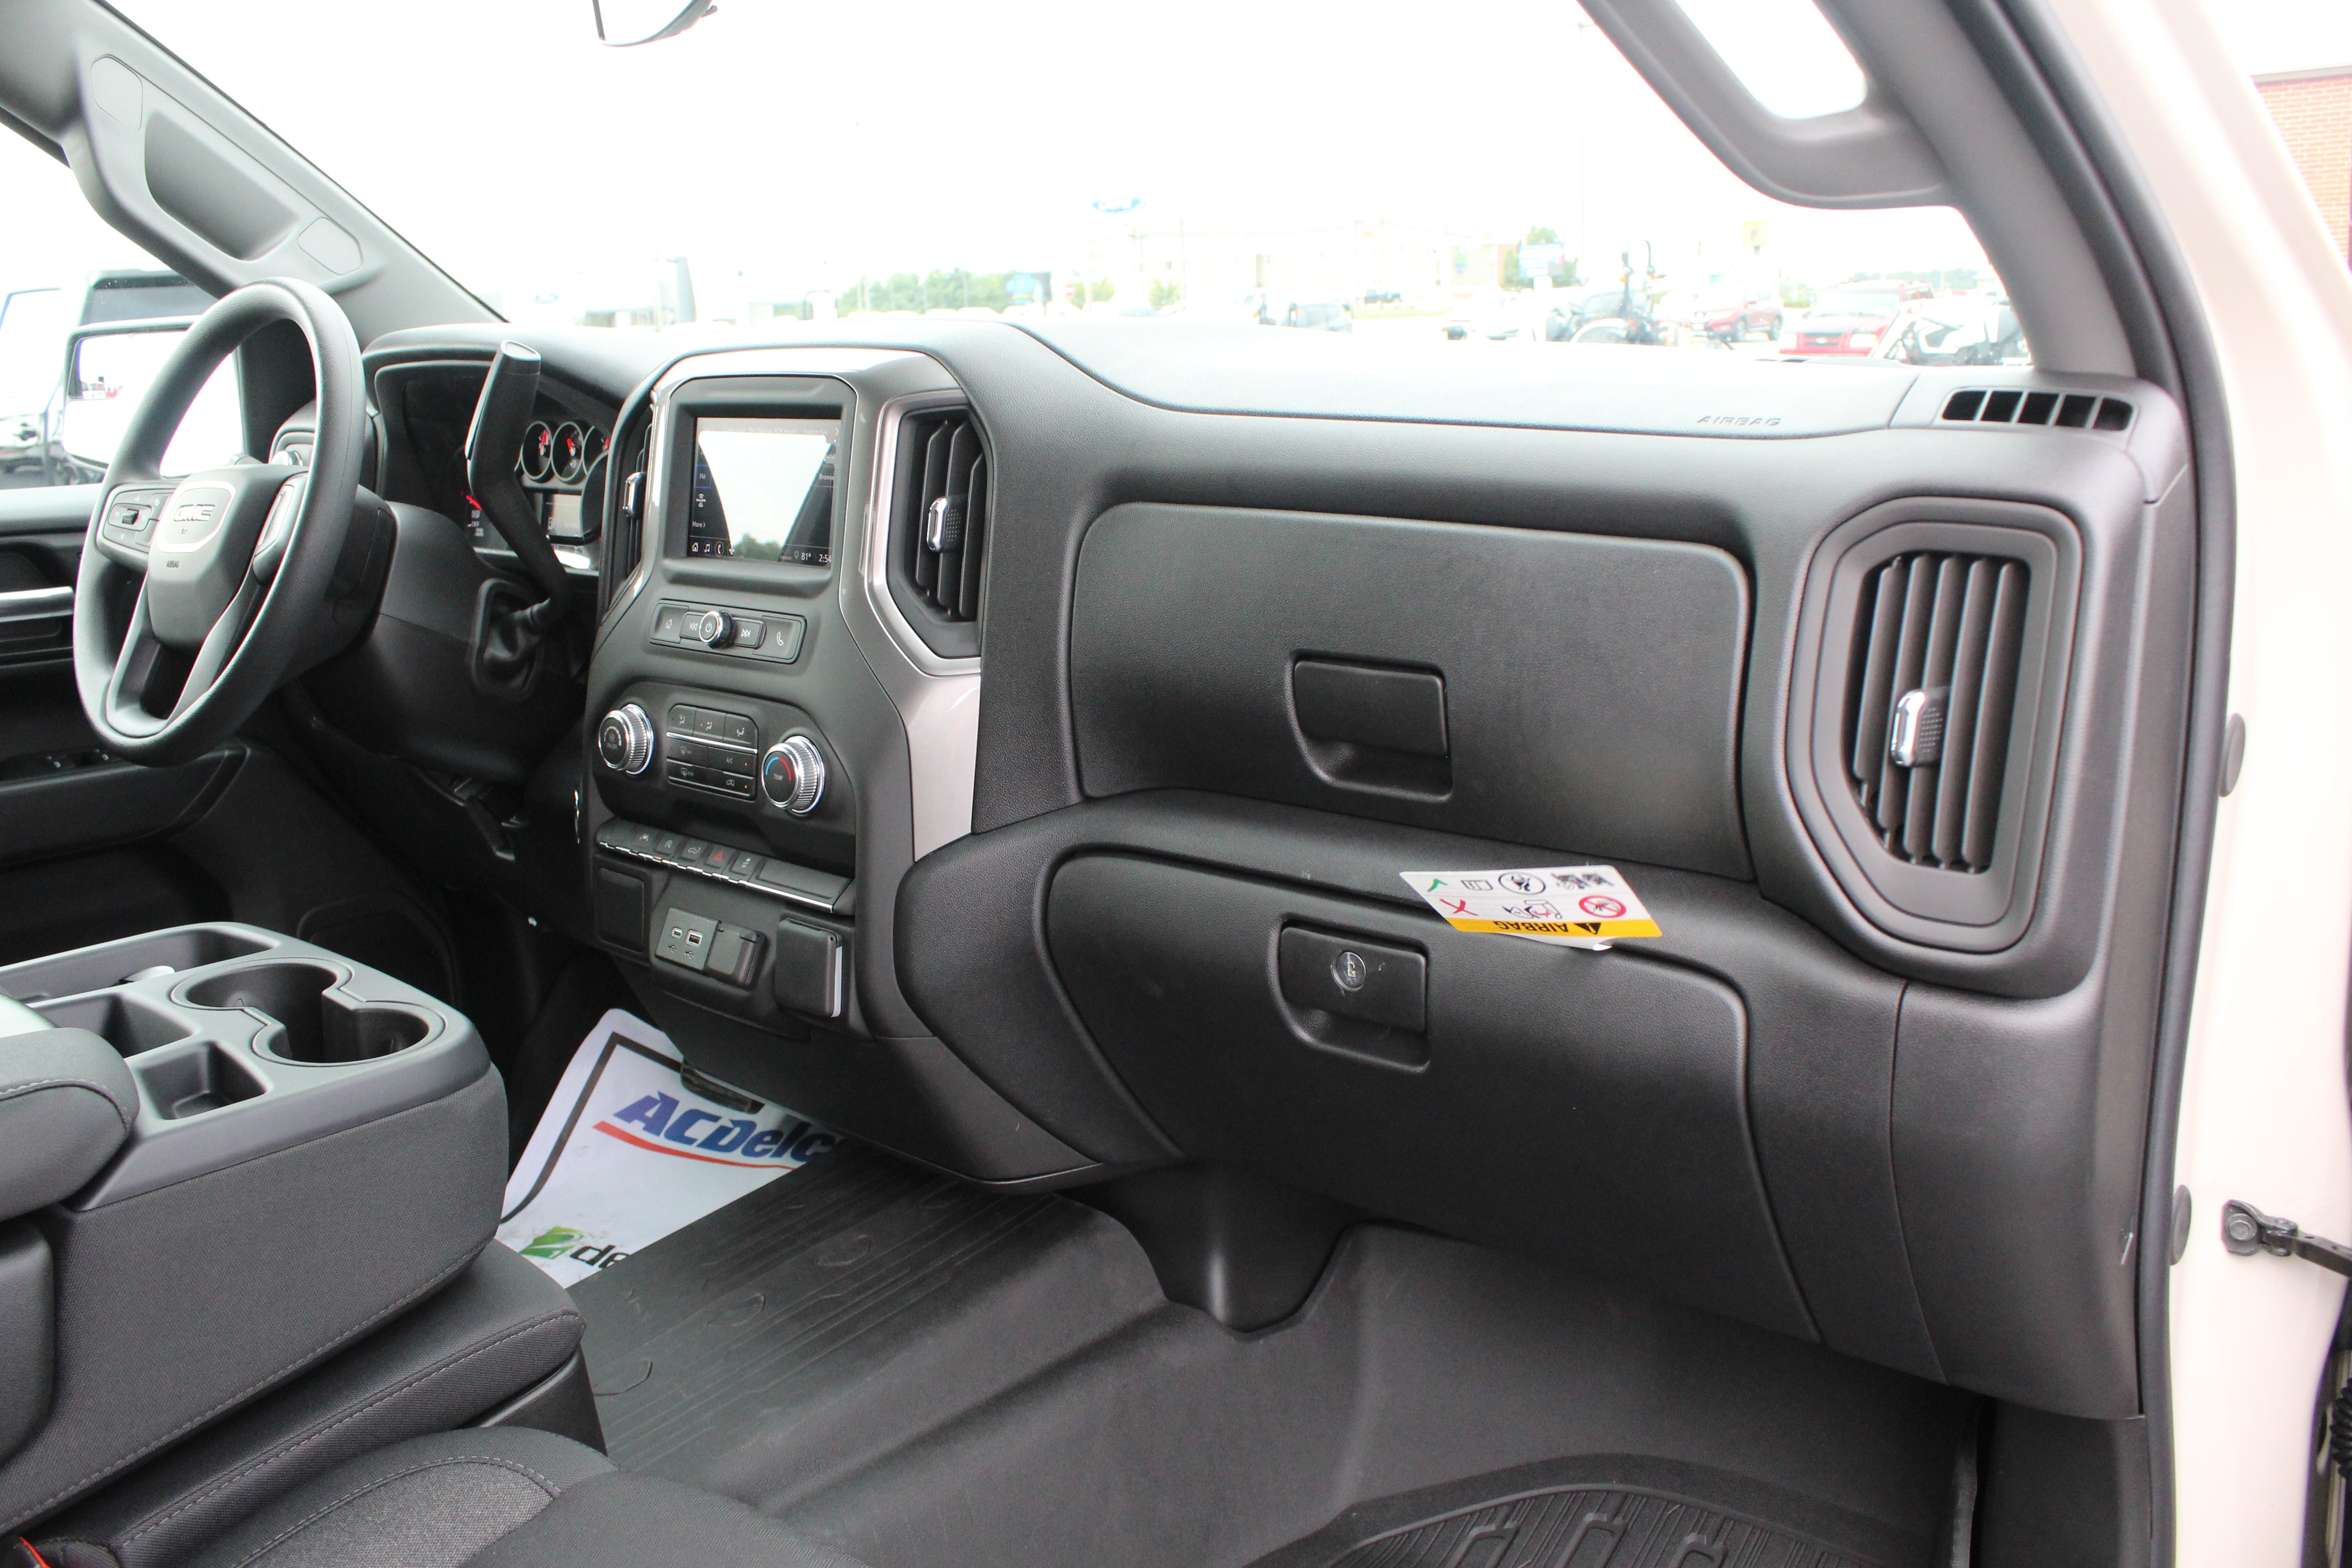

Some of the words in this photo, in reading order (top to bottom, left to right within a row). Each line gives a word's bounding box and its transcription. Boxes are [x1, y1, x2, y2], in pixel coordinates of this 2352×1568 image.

[1697, 415, 1781, 426] AIRBAG
[174, 504, 216, 521] GMC
[818, 554, 832, 563] 2:54
[1493, 921, 1568, 932] AIRBAG
[612, 1091, 837, 1162] ACDelc
